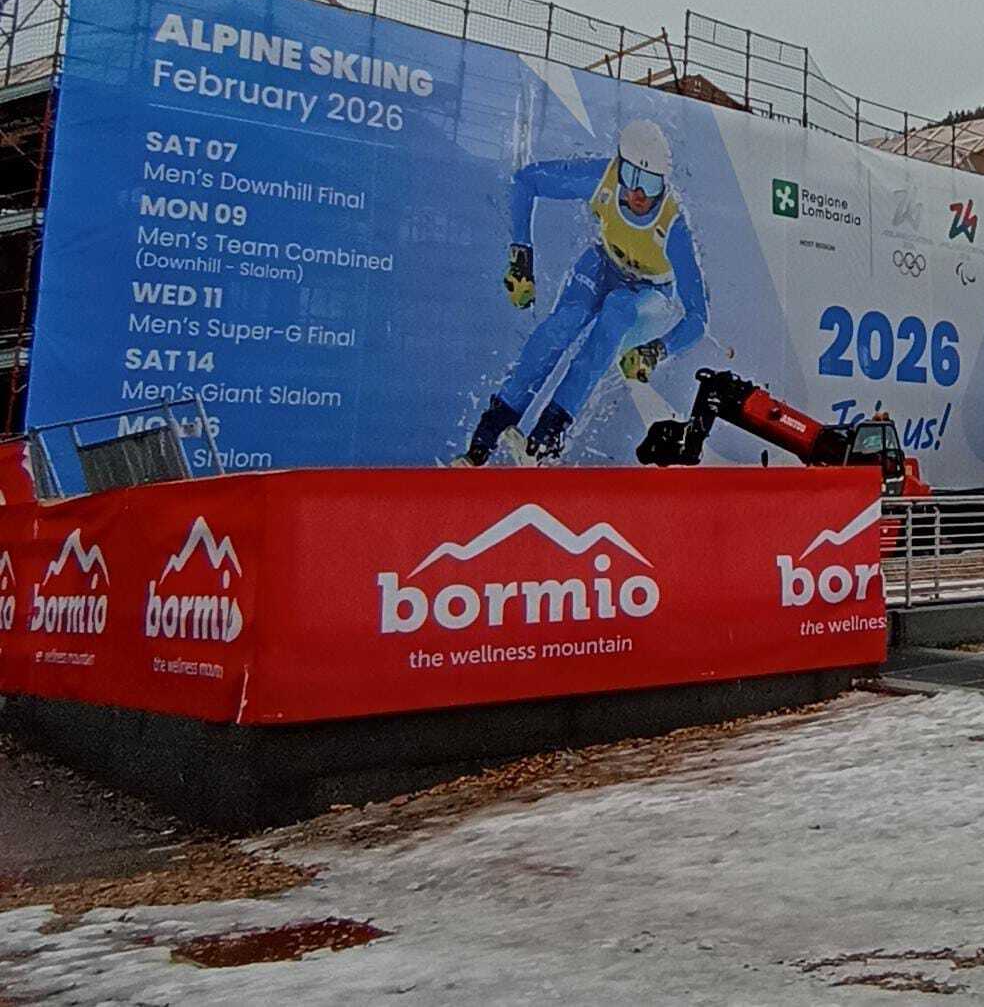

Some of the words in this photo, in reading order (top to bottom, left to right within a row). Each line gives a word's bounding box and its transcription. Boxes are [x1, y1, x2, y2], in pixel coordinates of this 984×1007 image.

[154, 13, 303, 70] ALPINE
[309, 47, 435, 96] SKIING
[153, 60, 318, 122] February
[327, 93, 404, 132] 2026
[145, 131, 203, 159] SAT
[206, 140, 238, 163] 07
[144, 162, 214, 188] Men's
[220, 172, 312, 202] Downhill
[318, 187, 366, 210] Final
[802, 189, 848, 210] Regione
[139, 195, 210, 223] MON
[215, 203, 247, 226] 09
[802, 204, 861, 226] Lombardia
[135, 249, 222, 275] (Downhill
[239, 260, 304, 284] Slalom)
[138, 226, 208, 252] Men's
[215, 234, 280, 258] Team
[285, 242, 394, 272] Combined
[133, 281, 198, 306] WED
[202, 286, 223, 308] 11
[128, 313, 200, 337] Men's
[207, 318, 302, 345] Super-G
[307, 326, 356, 347] Final
[818, 305, 960, 387] 2026
[125, 347, 180, 371] SAT
[186, 351, 215, 372] 14
[121, 380, 196, 403] Men's
[200, 383, 264, 404] Giant
[269, 385, 342, 407] Slalom
[903, 402, 953, 450] us!
[193, 448, 272, 468] Slalom
[377, 554, 660, 634] bormio
[776, 554, 886, 607] bor
[30, 573, 108, 635] bormio
[800, 619, 825, 636] the
[828, 614, 888, 633] wellnes
[409, 650, 444, 670] the
[450, 644, 537, 667] wellness
[542, 635, 634, 659] mountain
